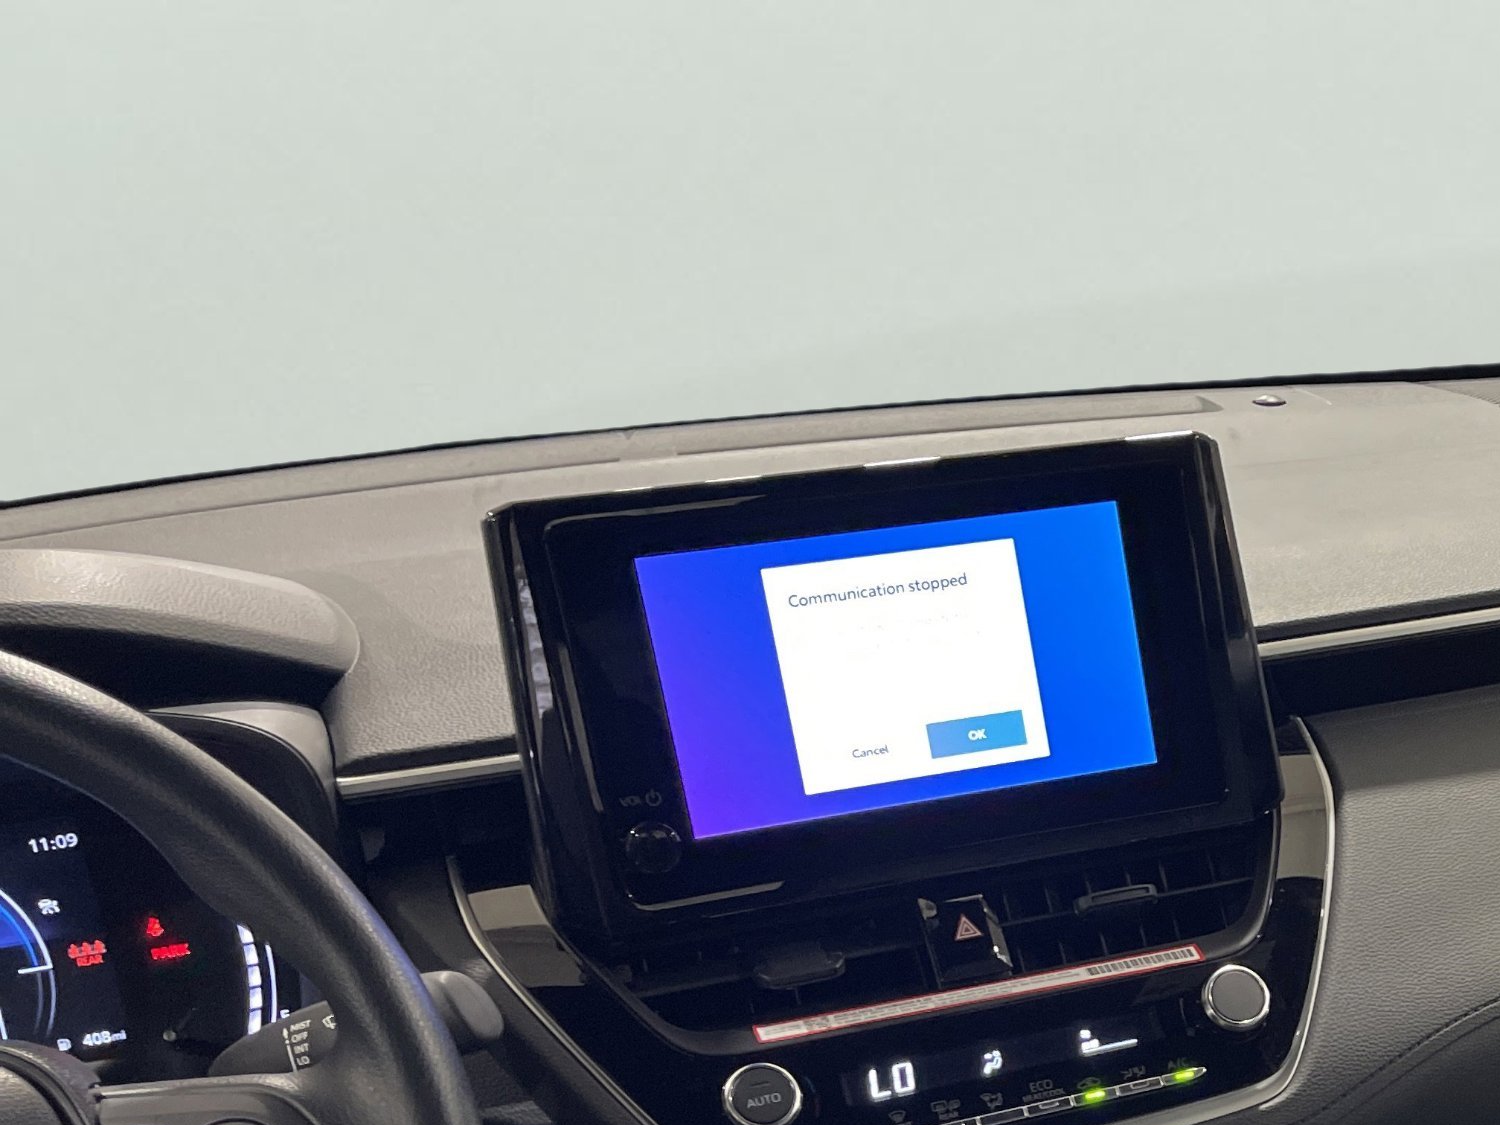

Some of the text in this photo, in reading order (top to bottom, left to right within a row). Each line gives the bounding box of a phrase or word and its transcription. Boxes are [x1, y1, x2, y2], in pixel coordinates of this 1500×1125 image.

[788, 572, 968, 608] Communication stopped
[852, 728, 987, 759] Cancel OK
[28, 832, 78, 853] 11:09
[76, 953, 104, 967] REAR
[296, 1055, 310, 1066] LO
[868, 1062, 916, 1100] LO
[1029, 1079, 1053, 1093] ECO
[747, 1092, 782, 1109] AUTO
